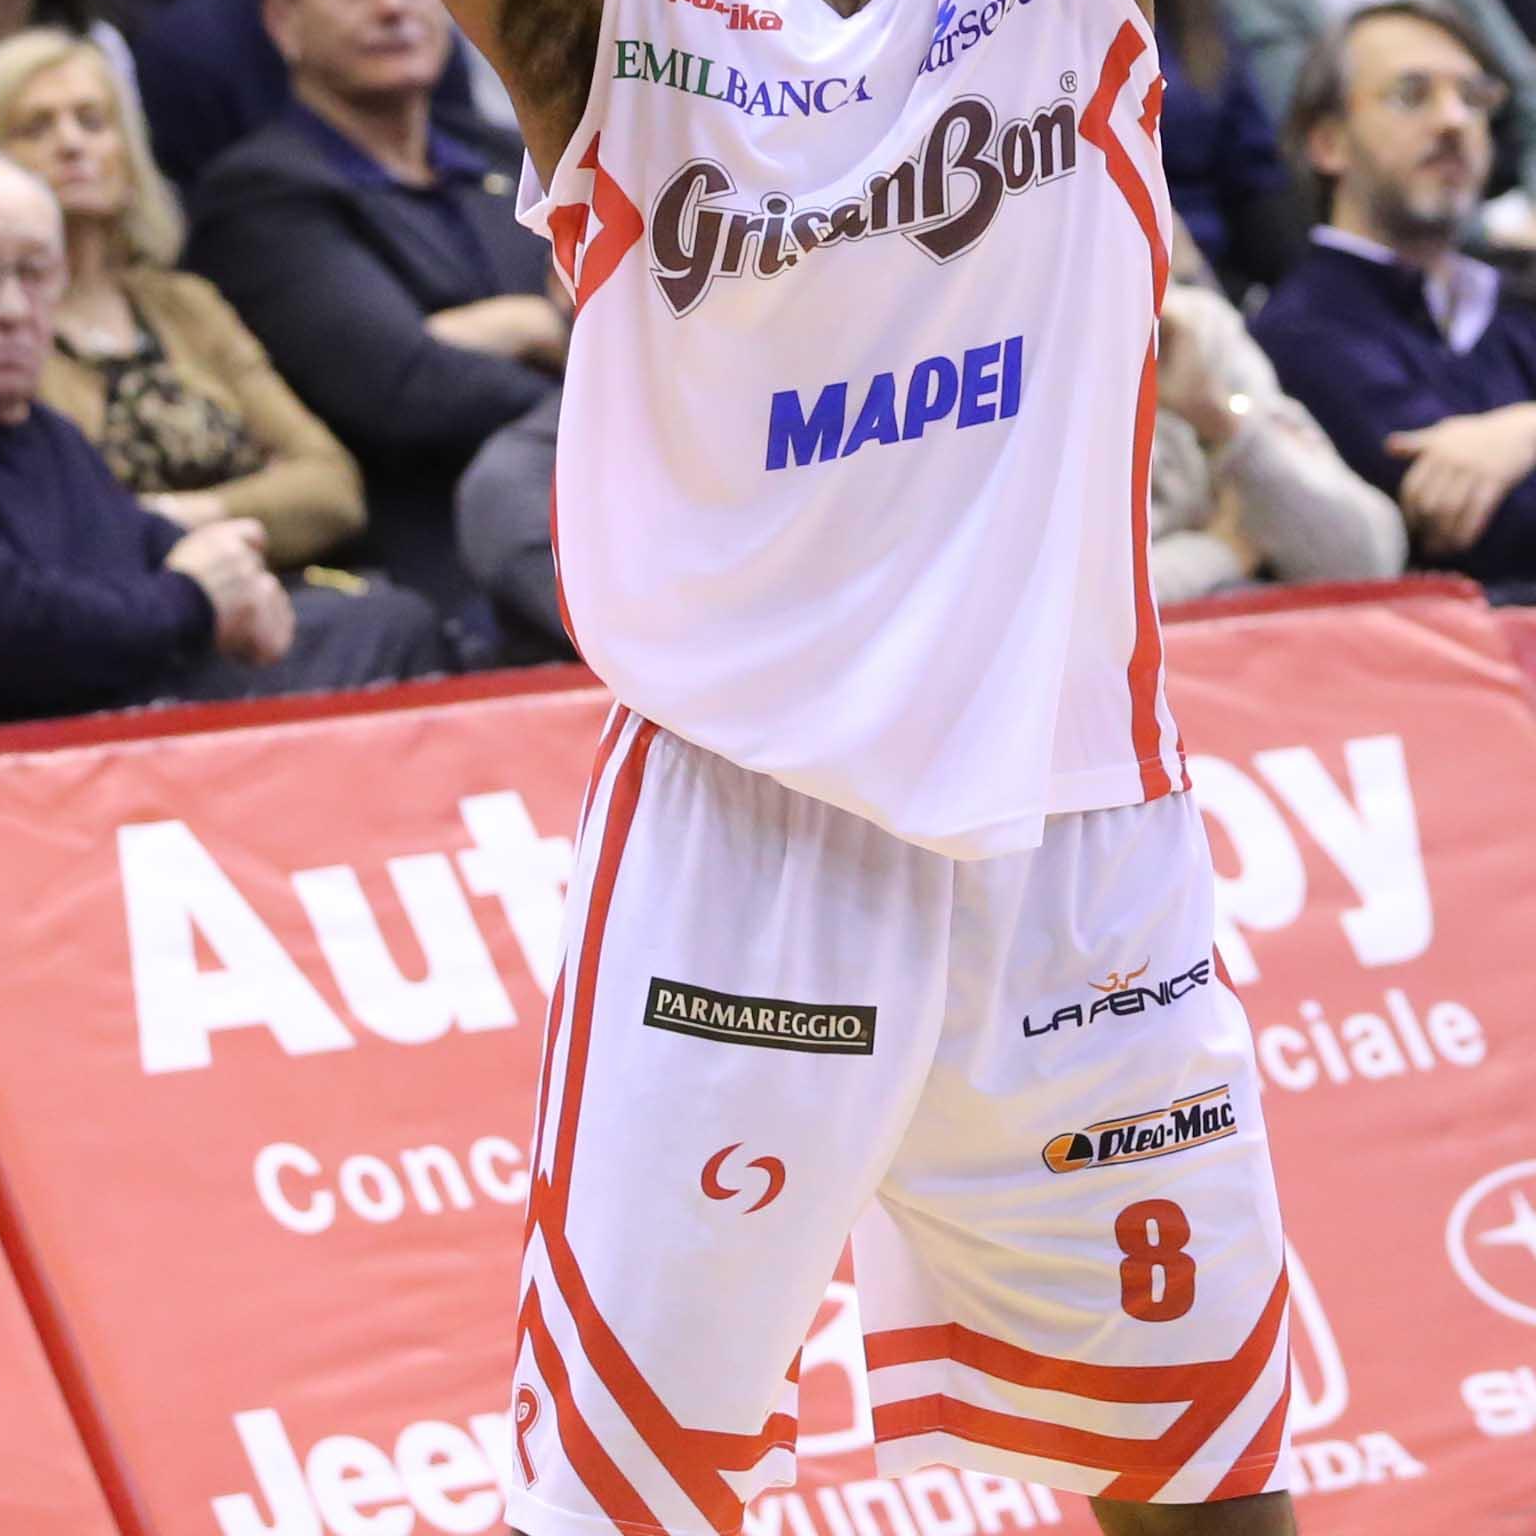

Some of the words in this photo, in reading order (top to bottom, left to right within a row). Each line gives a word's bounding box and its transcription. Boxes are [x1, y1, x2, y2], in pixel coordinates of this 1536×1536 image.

[764, 334, 1024, 472] MAPEI
[116, 789, 576, 1076] Aut
[1184, 732, 1434, 986] py
[655, 988, 863, 1040] PARMAREGGIO
[1022, 1004, 1083, 1038] LA
[1088, 958, 1210, 1024] FENICE
[253, 1134, 533, 1235] Conc
[1257, 985, 1488, 1093] ciale
[1113, 1197, 1198, 1324] 8
[743, 1467, 1062, 1536] YUNDAI
